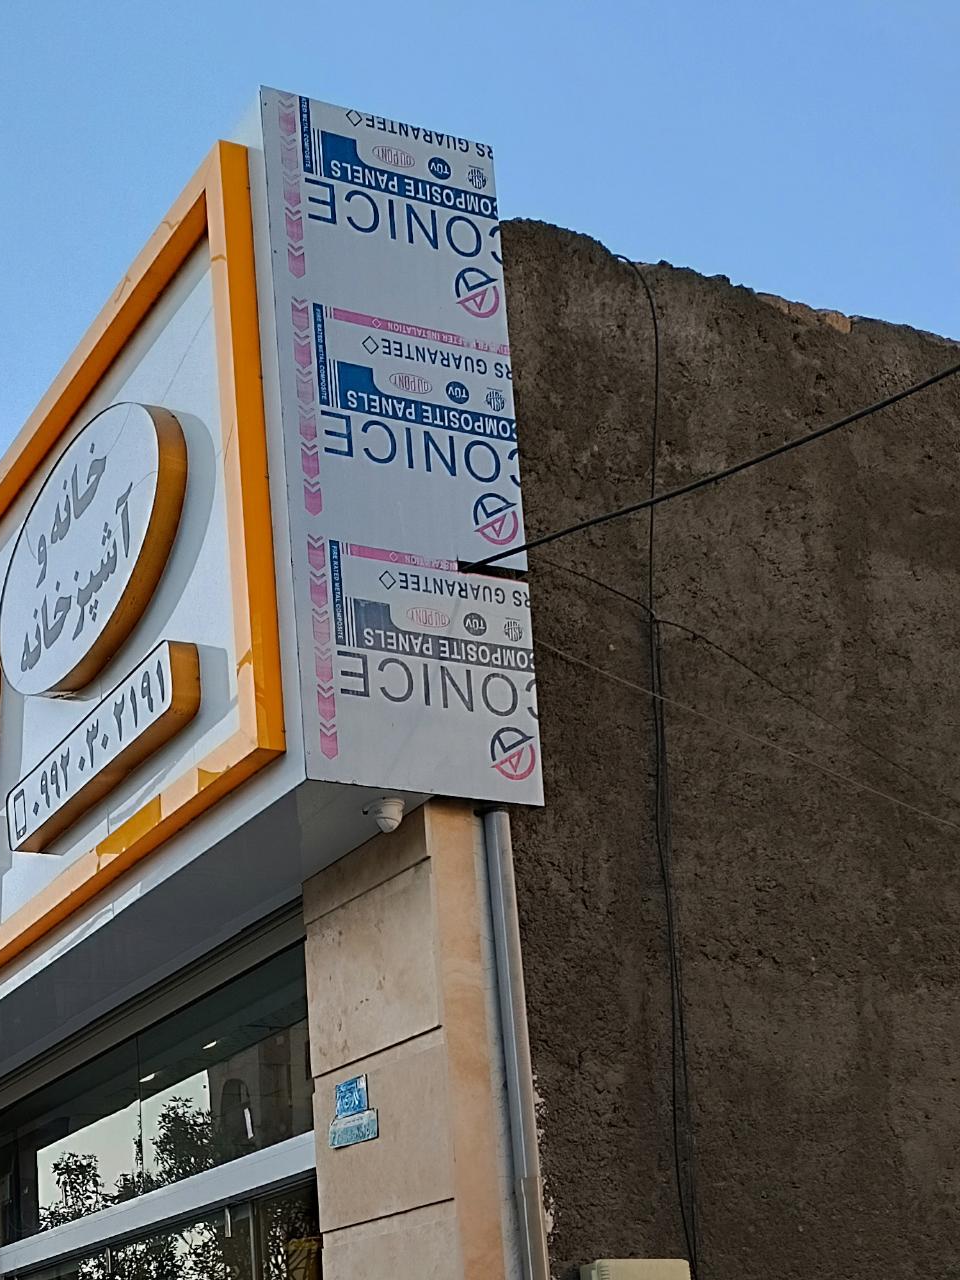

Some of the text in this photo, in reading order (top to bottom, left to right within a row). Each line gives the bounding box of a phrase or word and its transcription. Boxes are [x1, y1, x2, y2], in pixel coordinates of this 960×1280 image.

[364, 113, 469, 153] GUARANTEE
[330, 159, 397, 191] PANELS
[381, 337, 487, 375] GUARANTEE
[346, 389, 415, 419] PANELS
[447, 385, 467, 399] TÜV
[36, 442, 107, 588] خانه و
[21, 481, 133, 673] آشپزخانه
[398, 572, 505, 603] GUARANTEE
[464, 617, 485, 631] TÜV
[362, 627, 432, 654] PANELS
